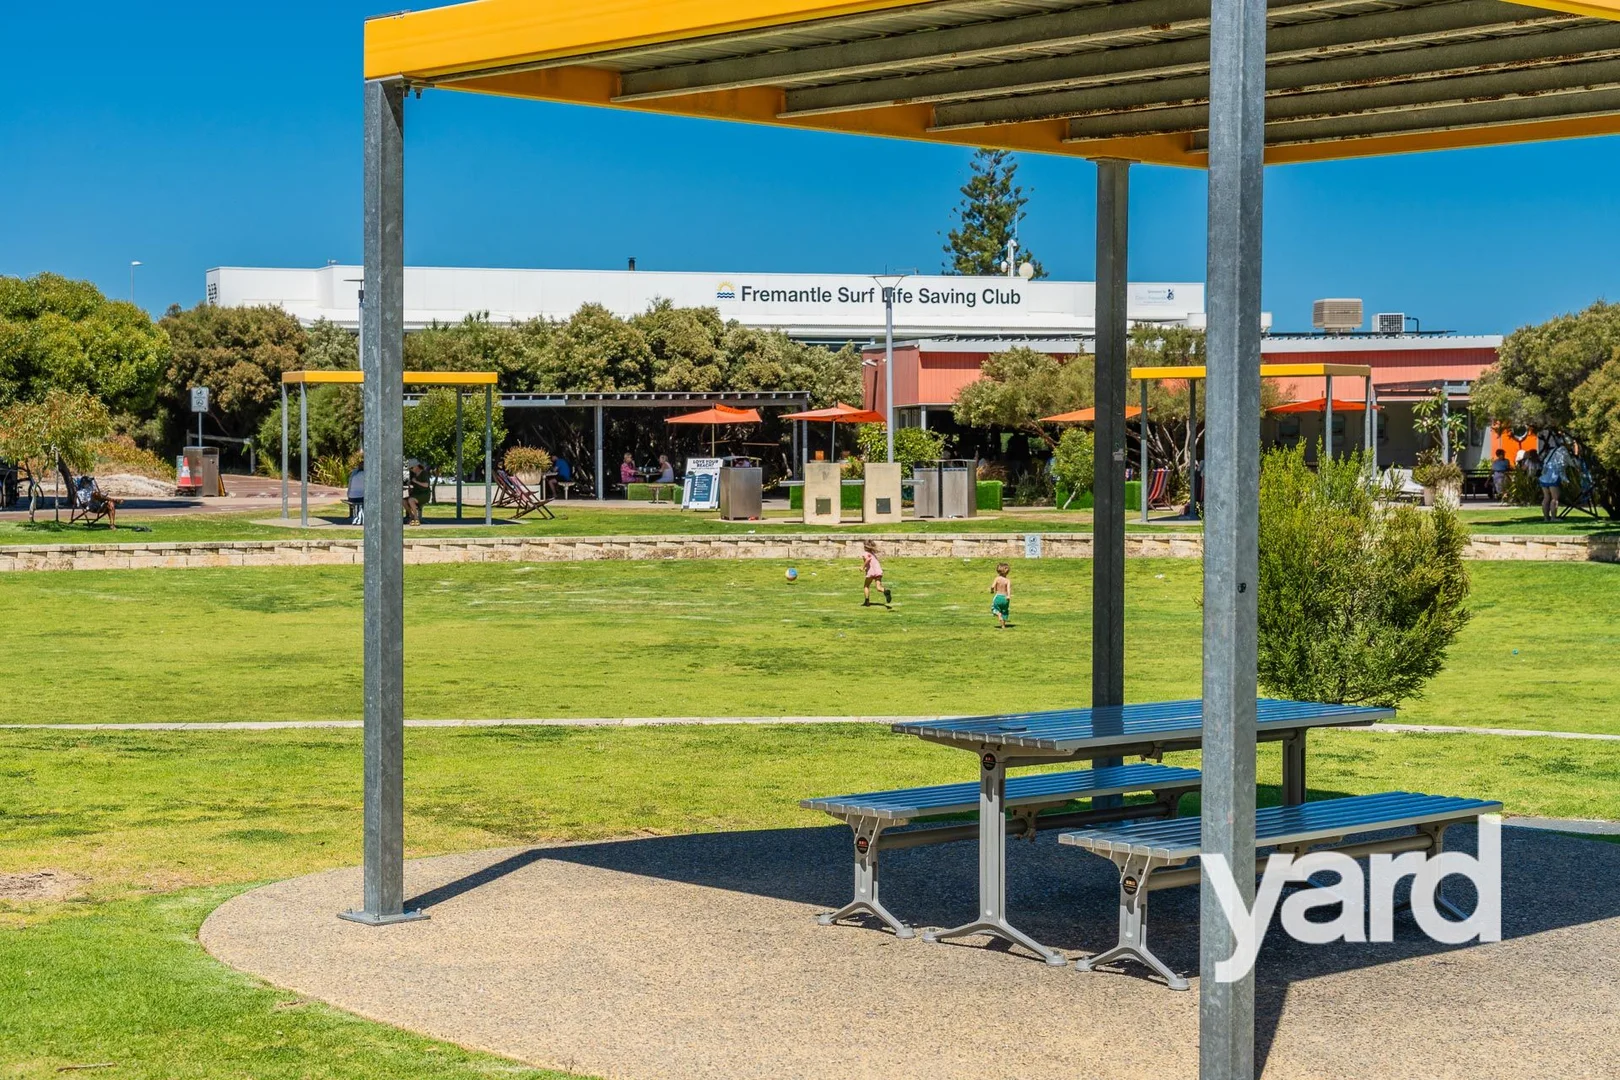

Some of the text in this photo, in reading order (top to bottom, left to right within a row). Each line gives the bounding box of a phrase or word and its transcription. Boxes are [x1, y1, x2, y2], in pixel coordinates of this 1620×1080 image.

[741, 285, 832, 303] Fremantle
[837, 286, 875, 303] Surf
[918, 287, 977, 308] Saving
[982, 288, 1021, 304] Club
